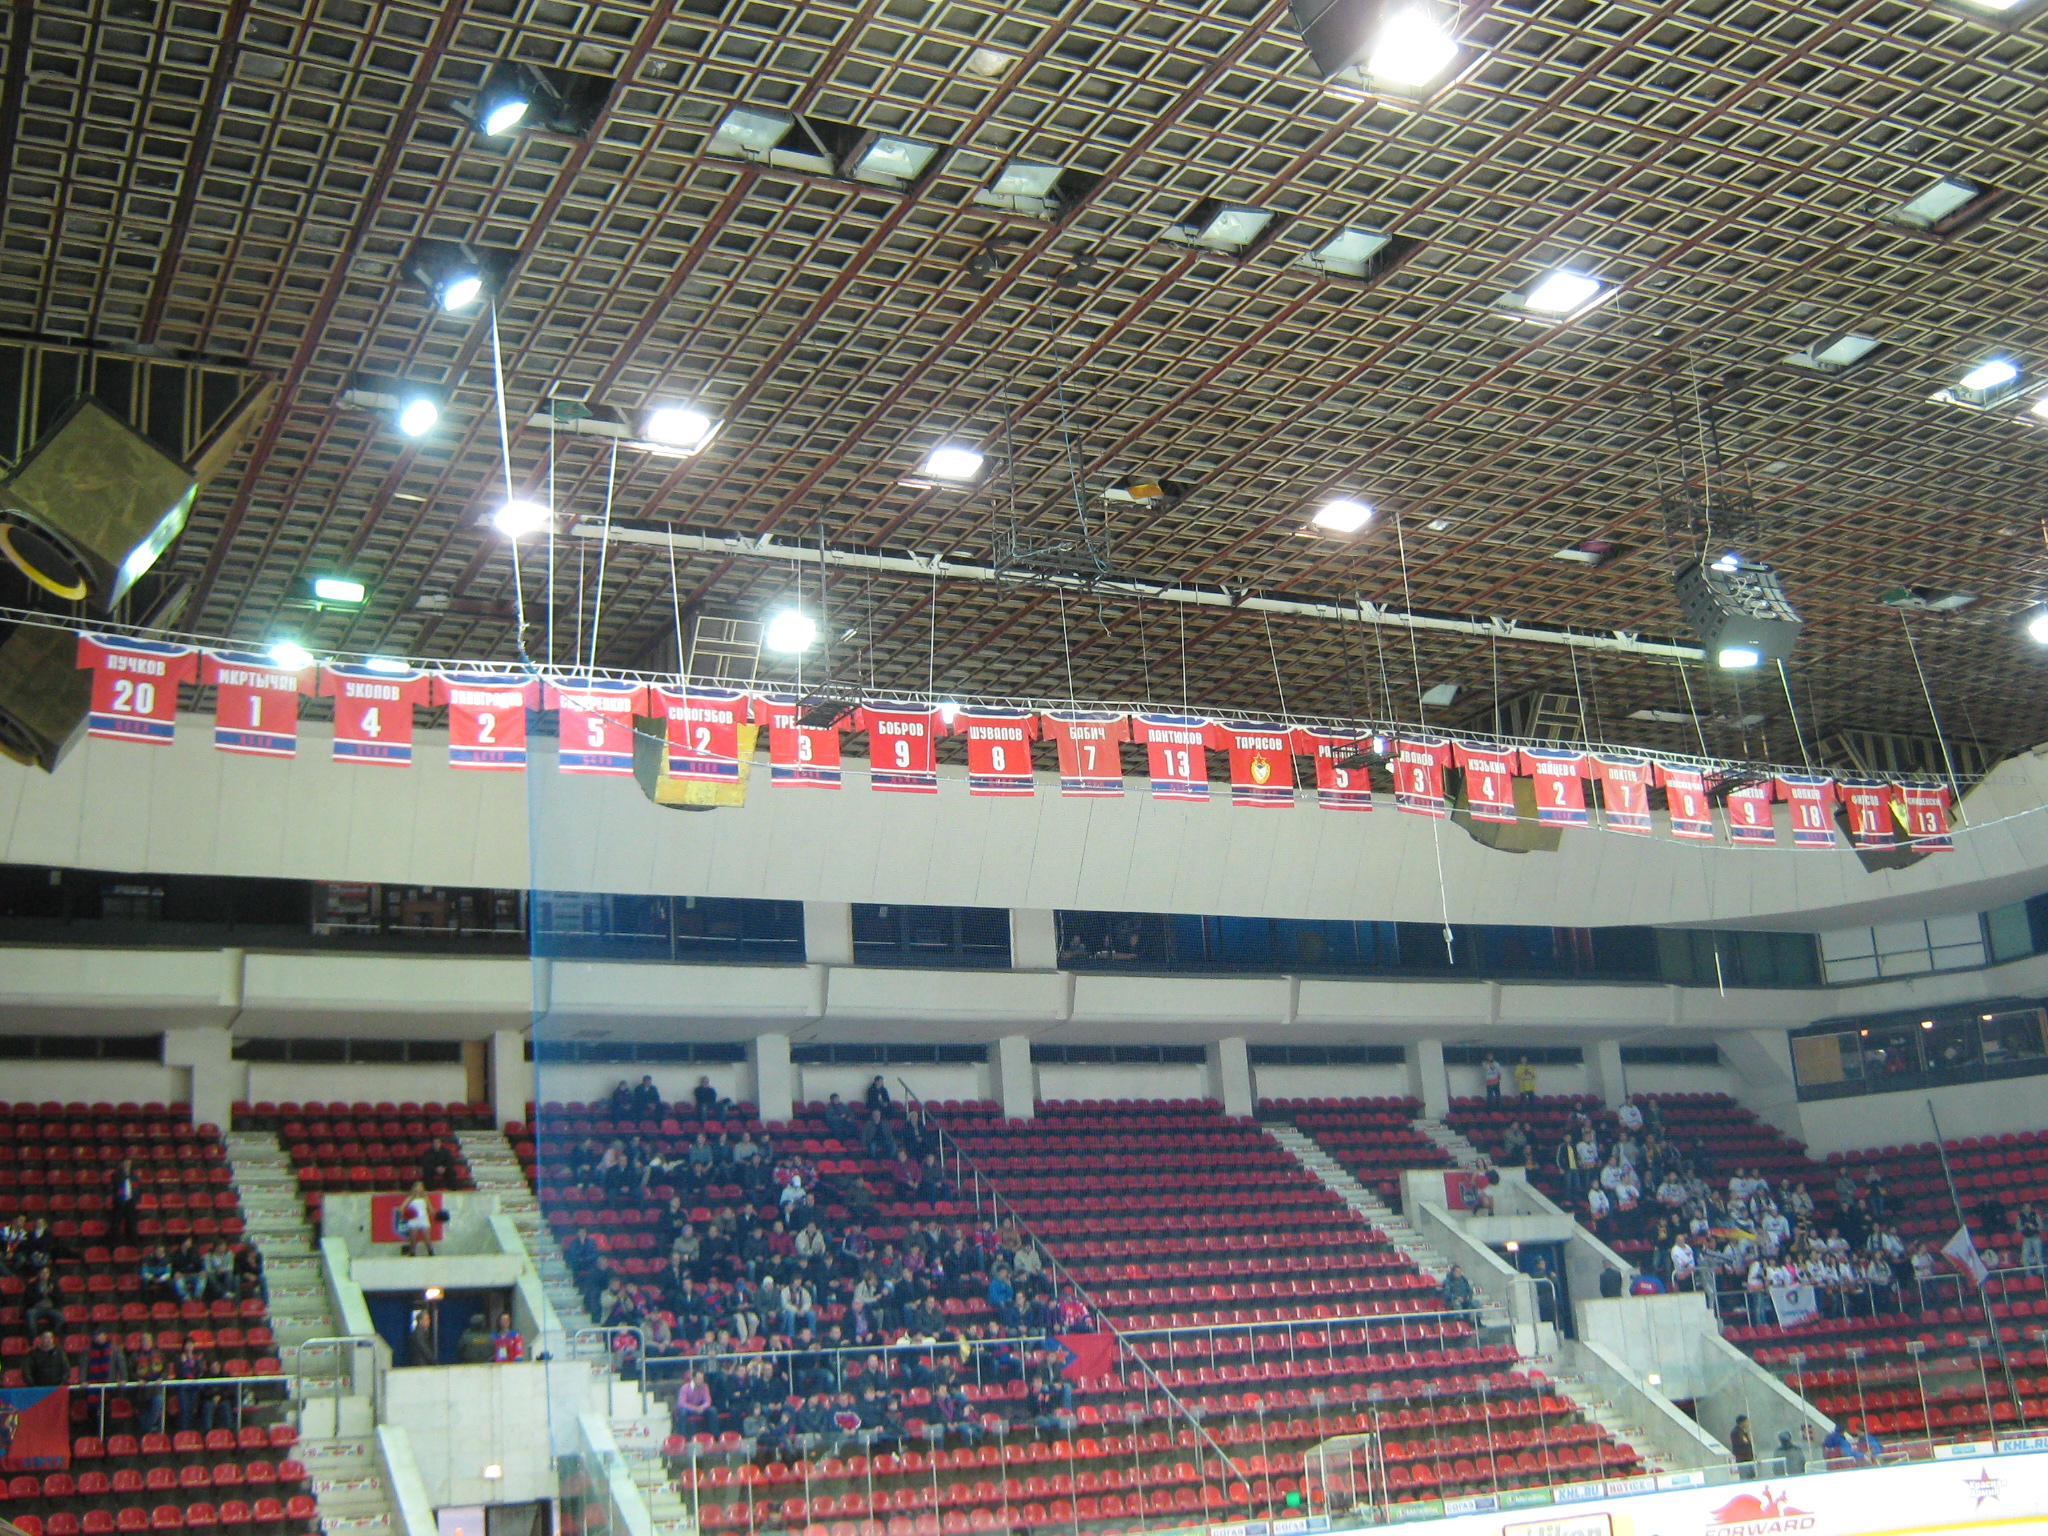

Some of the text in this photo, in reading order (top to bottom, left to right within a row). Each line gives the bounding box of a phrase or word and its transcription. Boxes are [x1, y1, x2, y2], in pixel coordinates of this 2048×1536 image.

[107, 654, 166, 676] ПУЧКОВ
[113, 679, 155, 714] 20
[345, 682, 400, 701] УКОЛОВ
[249, 695, 262, 727] 1
[361, 707, 381, 737] 4
[668, 707, 733, 724] СОЛОГУБОВ
[478, 713, 496, 743] 2
[587, 718, 605, 747] 5
[879, 720, 924, 737] БОБРОВ
[969, 726, 1023, 741] ШУВАЛОВ
[1069, 726, 1106, 740] БАБИЧ
[1148, 729, 1203, 745] ПАНТЮХОВ
[696, 727, 711, 755] 2
[798, 735, 812, 761] 3
[1235, 736, 1283, 750] ТАРАСОВ
[895, 740, 910, 768] 9
[991, 746, 1006, 771] 8
[1083, 746, 1096, 771] 7
[1164, 749, 1190, 777] 13
[1468, 758, 1506, 774] КУЗЬКИН
[1413, 768, 1425, 793] 3
[1482, 776, 1495, 800] 4
[1552, 781, 1566, 806] 2
[1620, 785, 1631, 808] 7
[1683, 794, 1695, 817] 8
[1743, 802, 1756, 824] 9
[1800, 805, 1821, 827] 18
[1861, 810, 1877, 831] 11
[1918, 812, 1937, 832] 13
[2003, 1438, 2048, 1451] KHL.RU
[1559, 1485, 1599, 1500] KHL.RU
